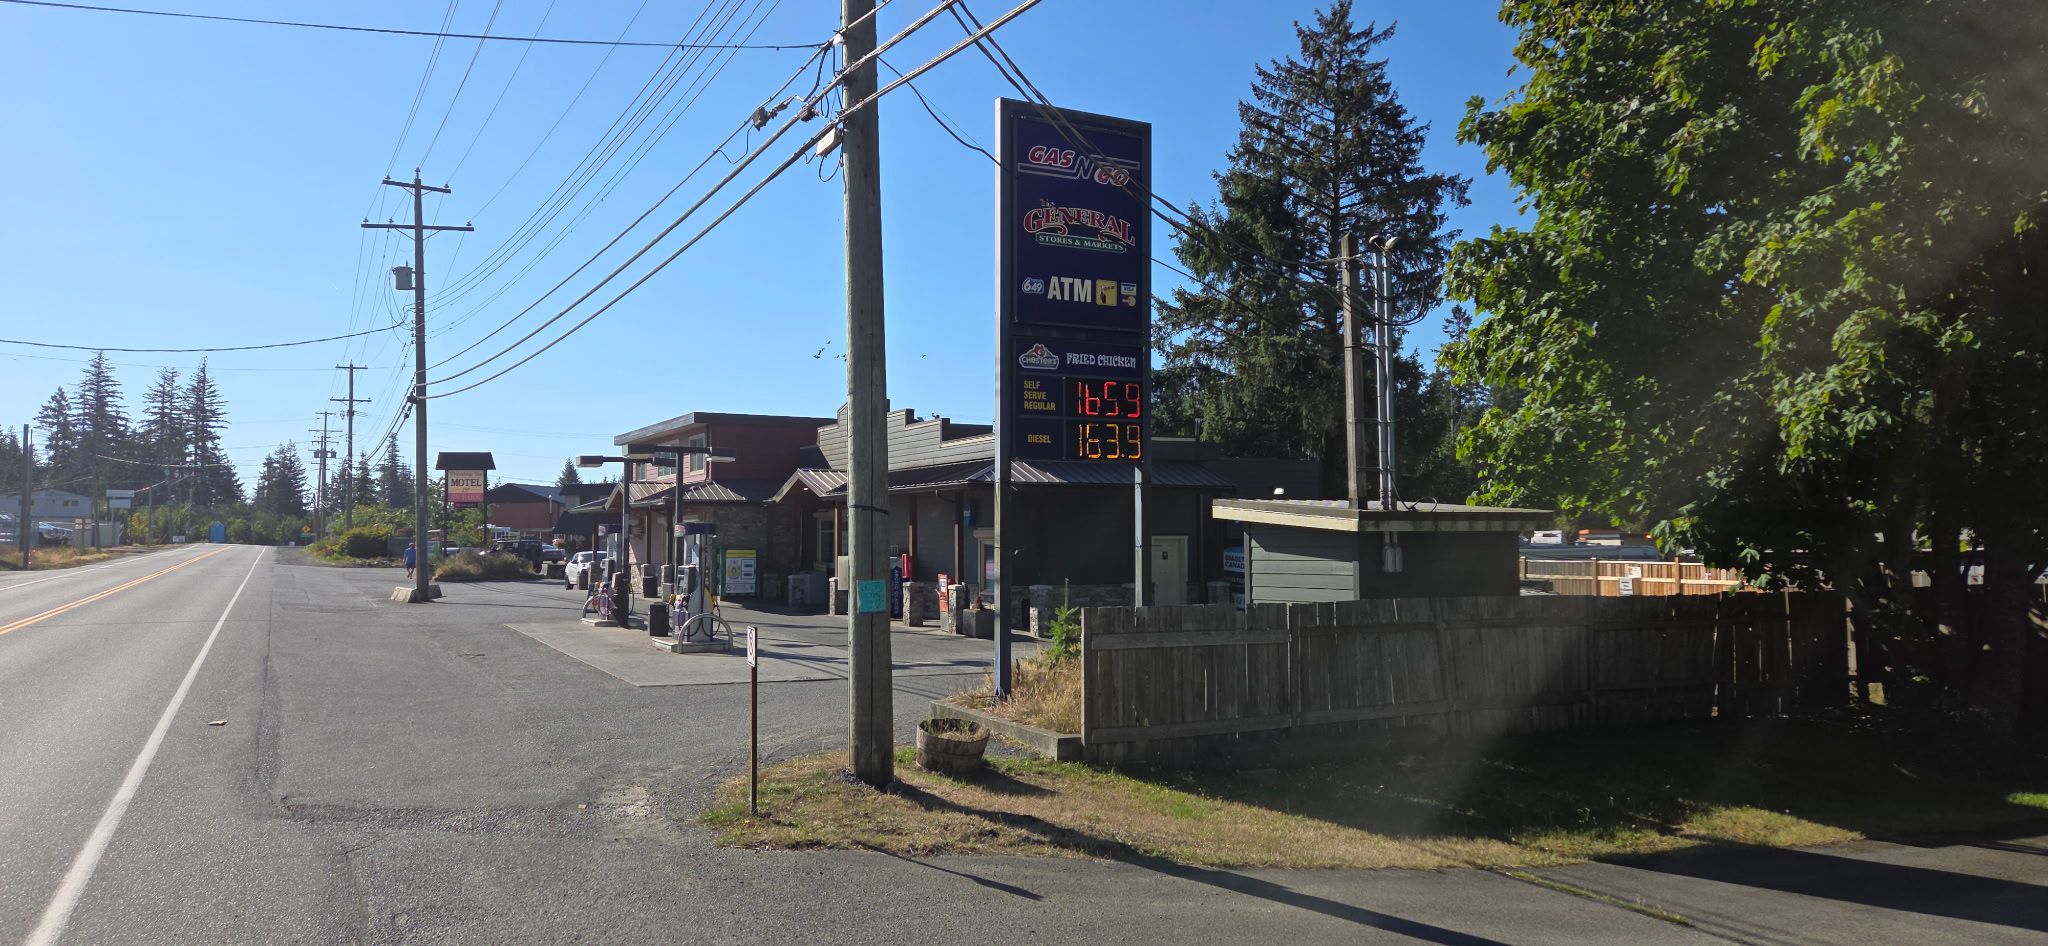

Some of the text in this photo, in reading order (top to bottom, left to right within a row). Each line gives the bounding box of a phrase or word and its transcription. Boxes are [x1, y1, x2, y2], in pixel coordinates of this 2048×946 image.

[1029, 145, 1075, 167] GAS
[1094, 167, 1130, 186] GO
[1023, 206, 1136, 247] GENERAL
[1039, 234, 1125, 252] STORES & MARKETS
[1023, 275, 1092, 303] 649 ATM
[1066, 353, 1137, 368] FRIED CHICKEN
[1023, 380, 1041, 390] SELF
[1023, 391, 1047, 401] SERVE
[1023, 402, 1056, 411] REGULAR
[1027, 434, 1051, 444] DIESEL
[451, 478, 482, 487] MOTEL
[1225, 561, 1245, 569] CANAD
